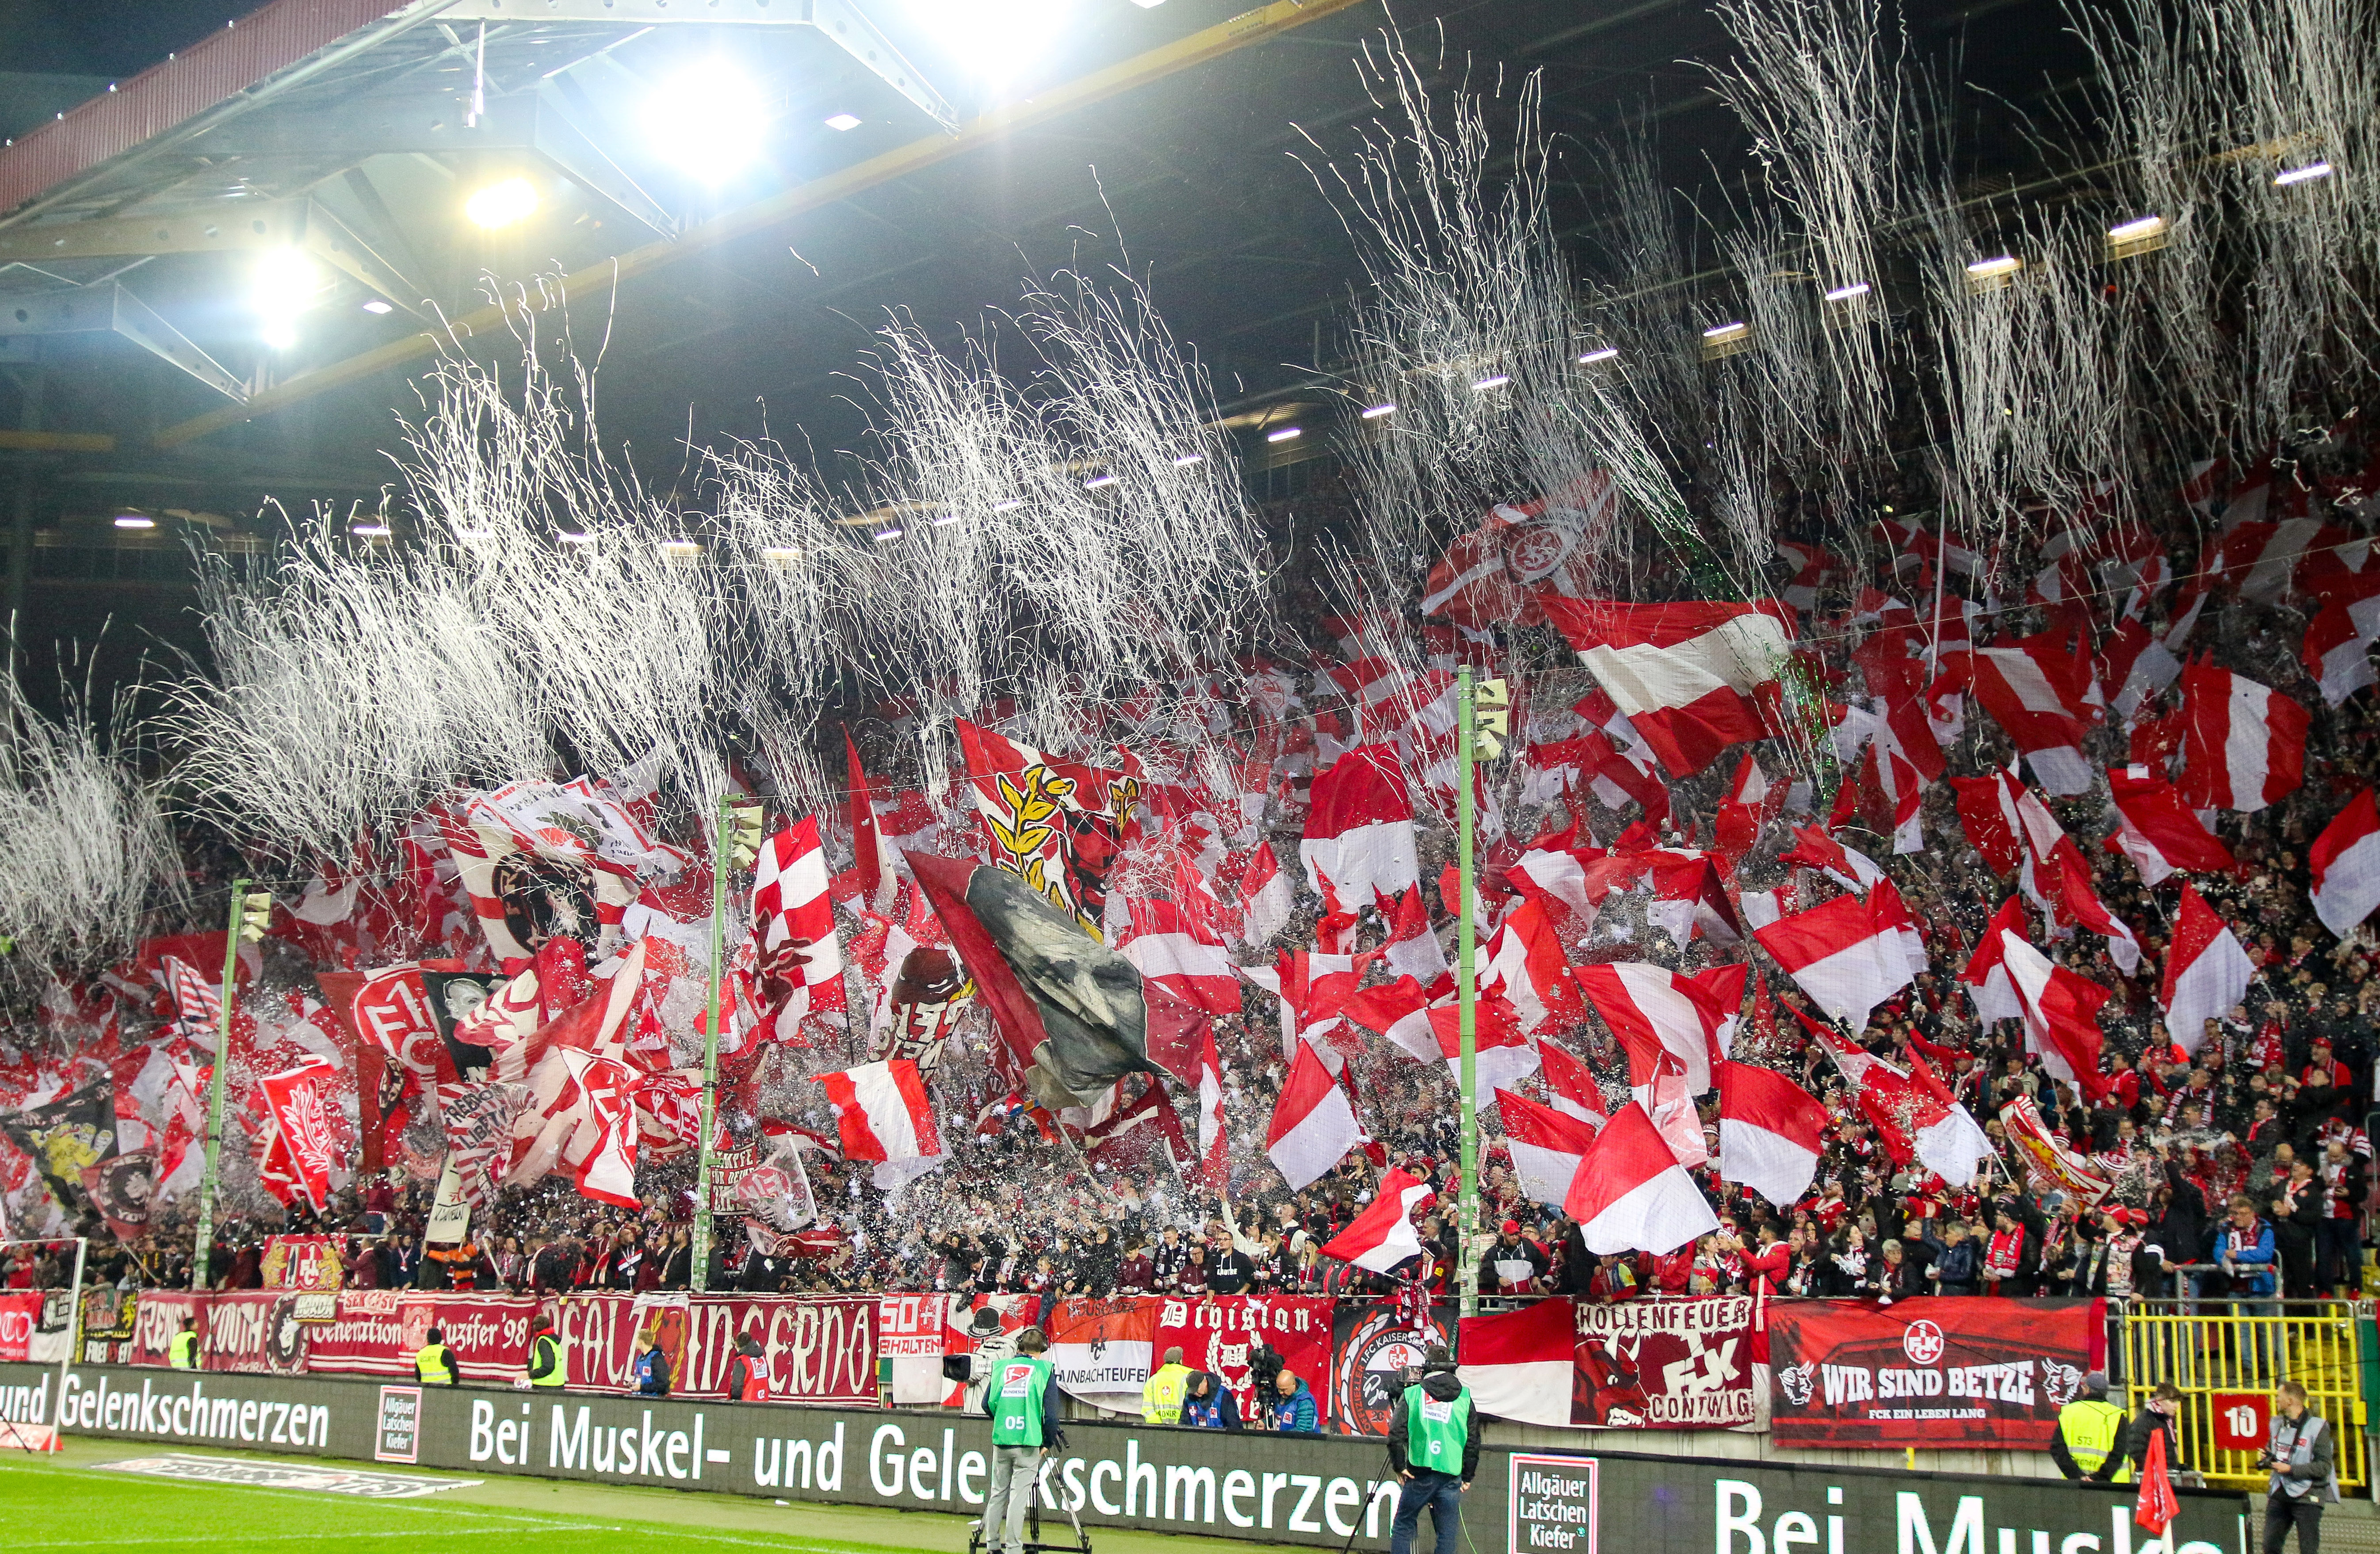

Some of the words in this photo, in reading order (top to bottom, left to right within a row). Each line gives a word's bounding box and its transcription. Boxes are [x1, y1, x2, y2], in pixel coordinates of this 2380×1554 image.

[879, 1296, 944, 1333] 50+1
[1821, 1362, 1874, 1406] WIR
[1878, 1368, 1943, 1399] SIND
[1947, 1360, 2035, 1406] BETZE
[0, 1372, 49, 1424] und
[60, 1373, 329, 1448] Gelenkschmerzen
[384, 1396, 416, 1417] Allgäuer
[1868, 1409, 1891, 1419] FCK
[1893, 1409, 1913, 1419] EIN
[1952, 1408, 1986, 1419] LANG
[382, 1415, 414, 1433] Latschen
[1005, 1416, 1025, 1430] 05
[2225, 1404, 2258, 1438] 10
[386, 1432, 408, 1450] Kiefer
[470, 1399, 530, 1466] Bei
[549, 1404, 730, 1480] Muskel-
[754, 1421, 844, 1492] und
[869, 1423, 1403, 1539] Gelekschmerzen
[1520, 1471, 1587, 1501] Allgäuer
[1519, 1496, 1587, 1524] Latschen
[1529, 1523, 1575, 1550] Kiefer
